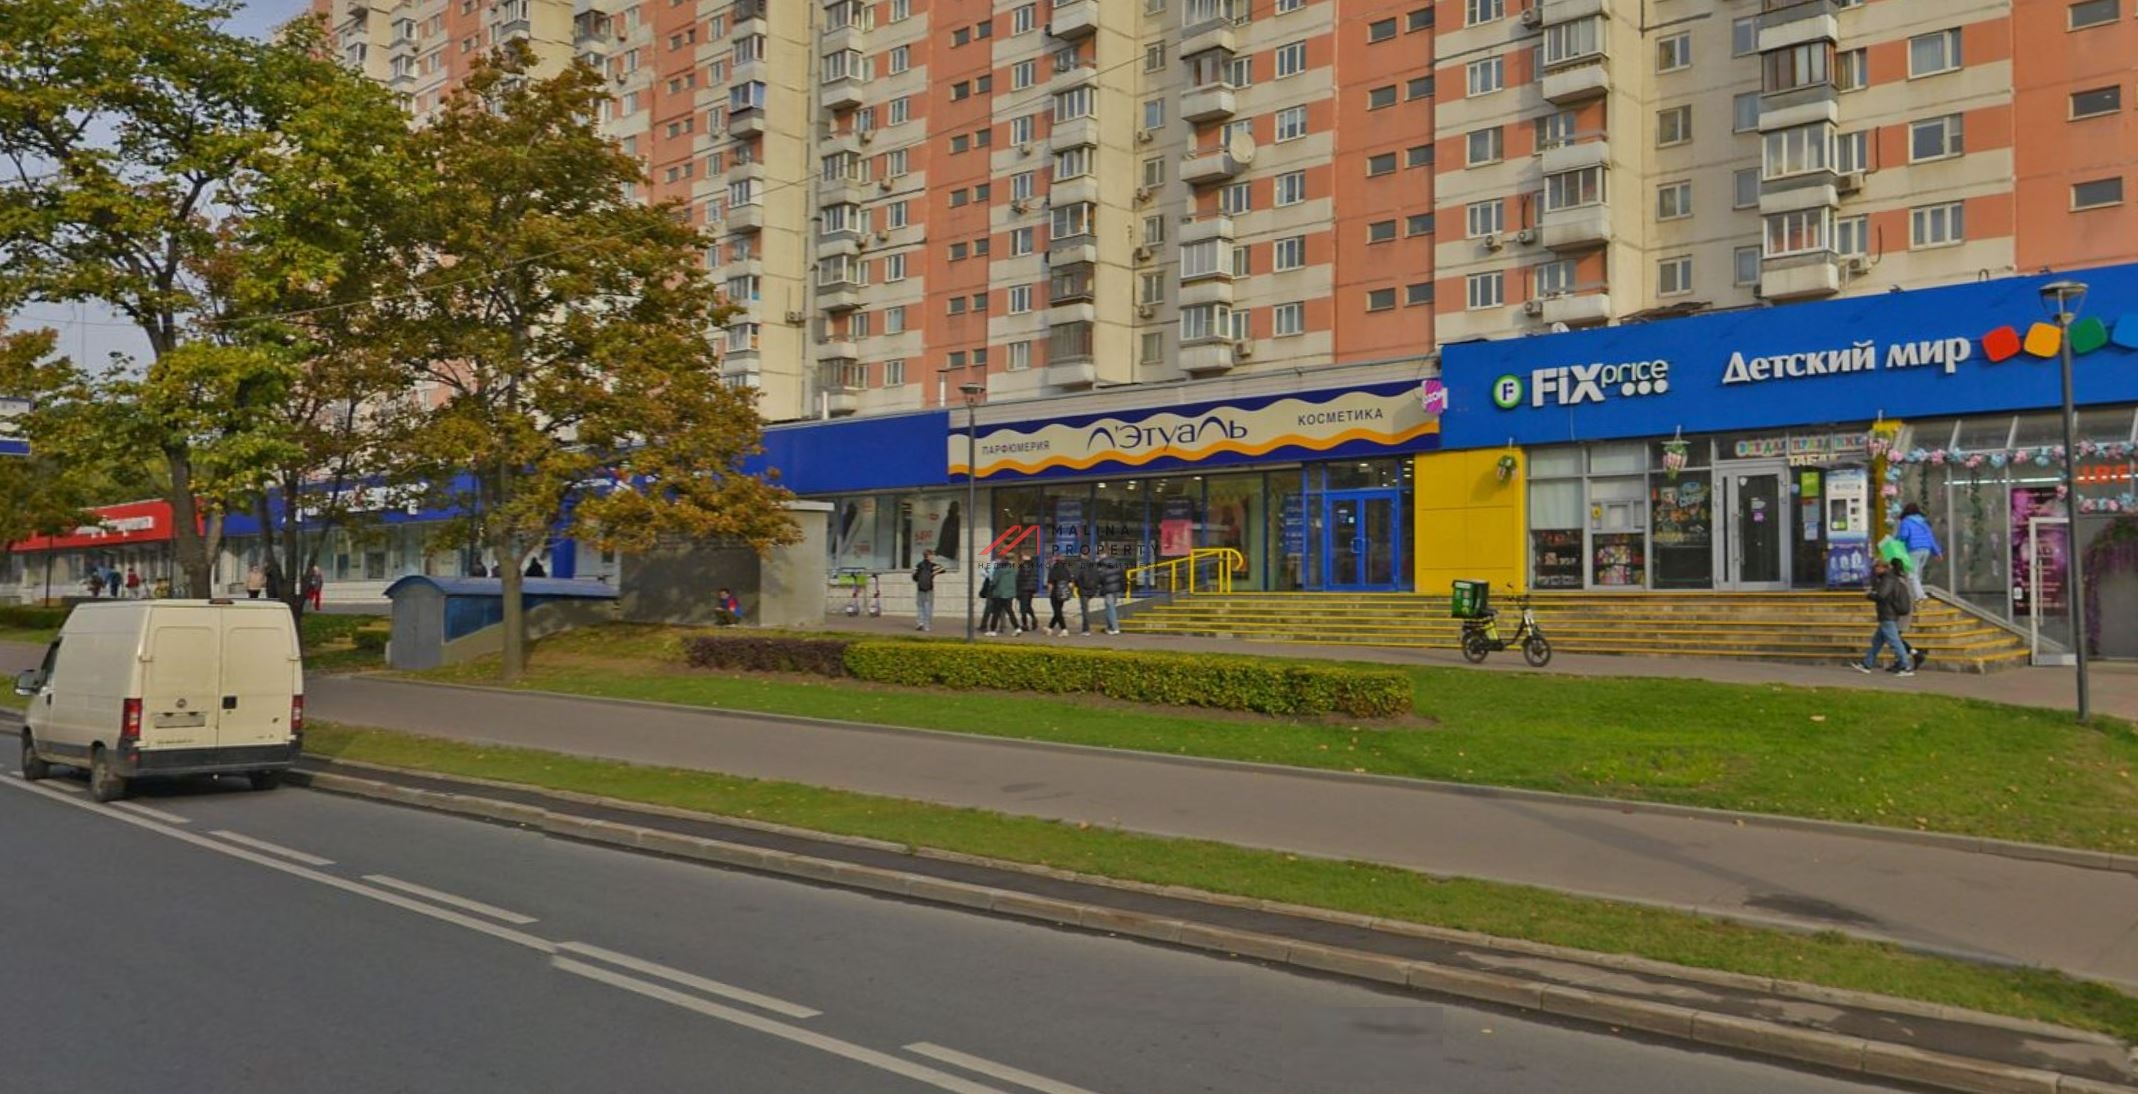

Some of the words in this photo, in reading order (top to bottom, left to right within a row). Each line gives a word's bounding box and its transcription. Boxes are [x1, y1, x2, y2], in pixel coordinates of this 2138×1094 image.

[1722, 340, 1876, 384] Детский
[1885, 337, 1971, 373] мир
[1601, 359, 1669, 388] price
[1298, 408, 1384, 426] КОСМЕТИКА
[982, 440, 1050, 455] ПАРФЮМЕРИЯ
